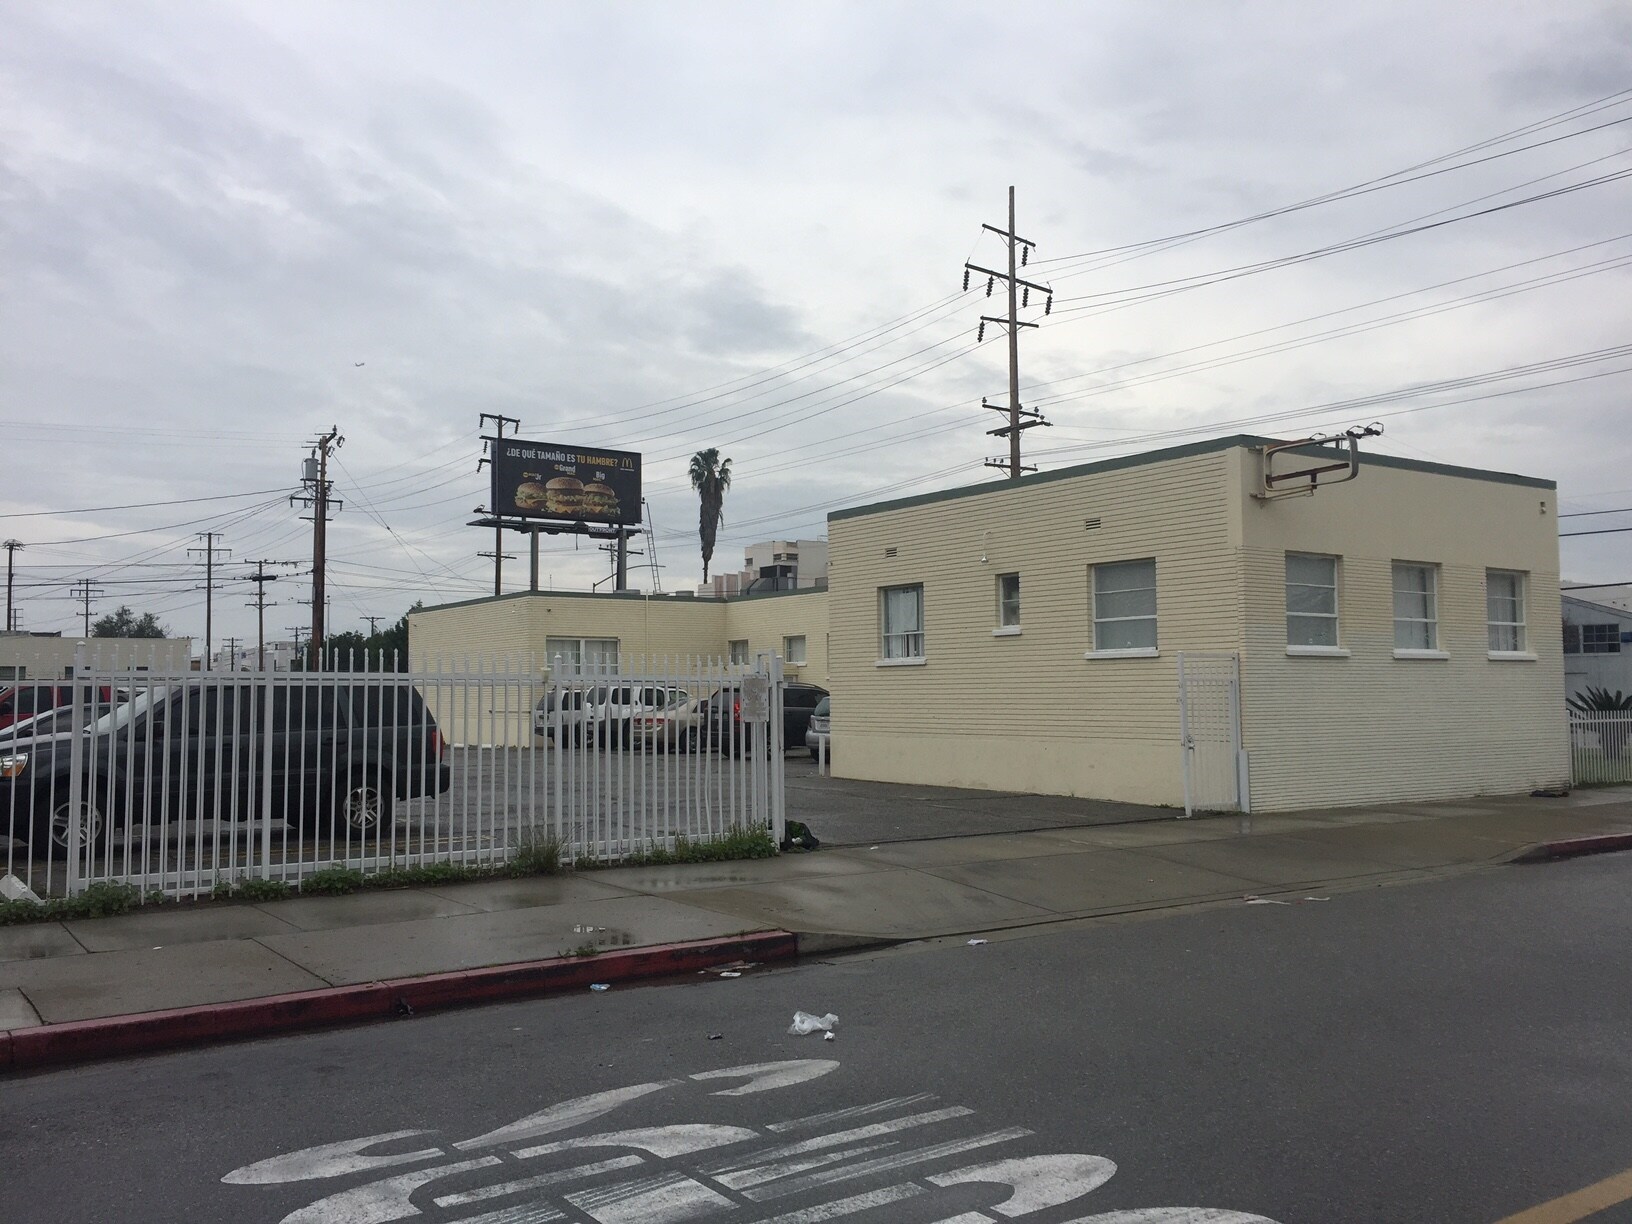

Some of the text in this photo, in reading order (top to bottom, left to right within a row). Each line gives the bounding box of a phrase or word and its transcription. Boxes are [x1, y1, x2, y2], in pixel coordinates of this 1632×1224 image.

[506, 448, 618, 467] ¿DE QUÉ TAMAÑO ES TU HAMBRE?
